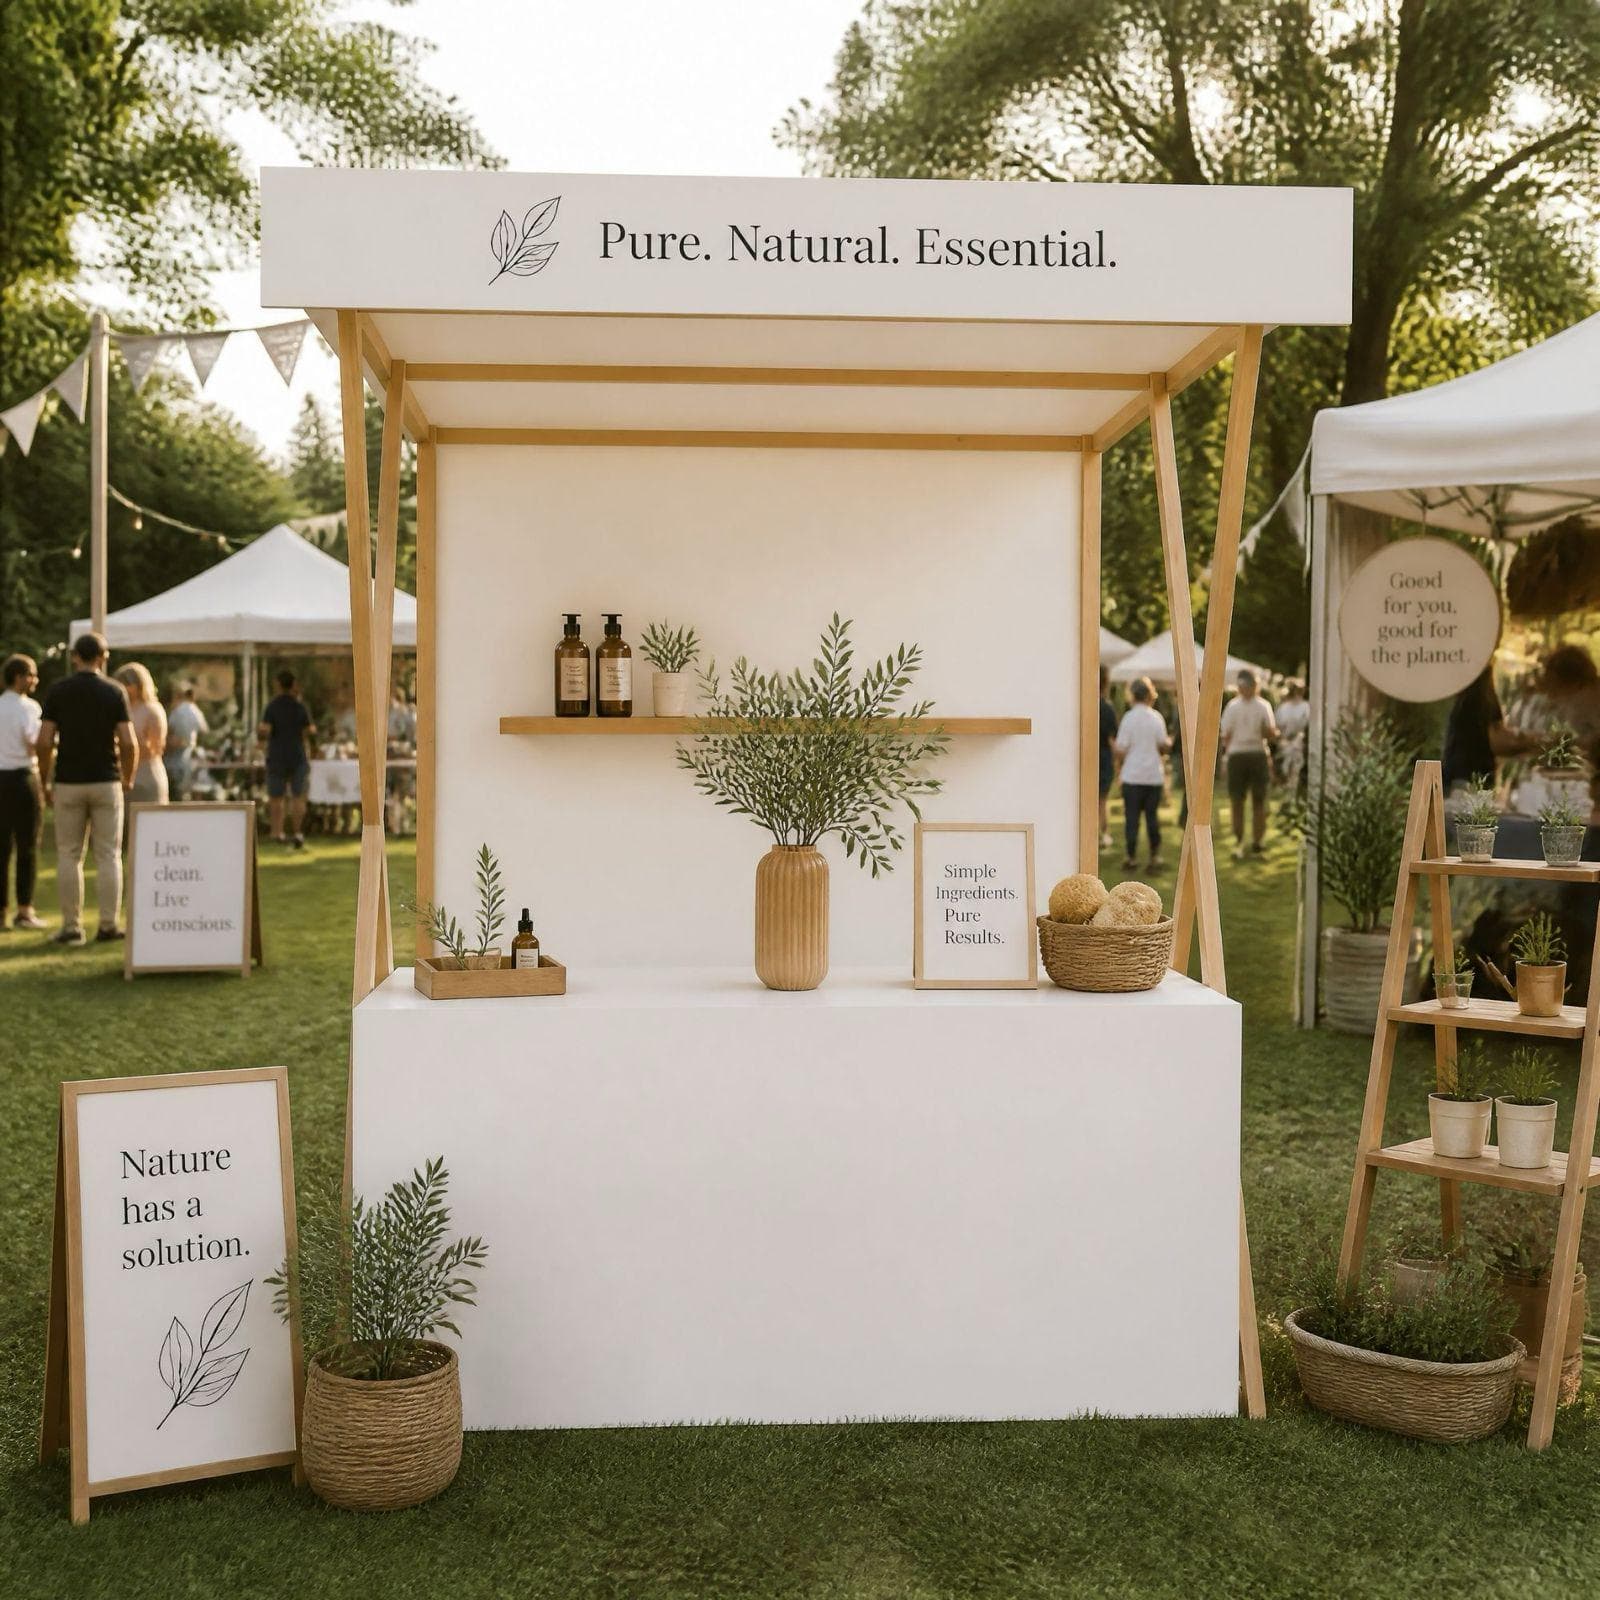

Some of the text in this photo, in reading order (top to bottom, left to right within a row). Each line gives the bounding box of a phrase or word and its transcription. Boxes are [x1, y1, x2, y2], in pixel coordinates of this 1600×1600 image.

[600, 221, 1118, 269] Pure. Natural. Essential.
[1389, 571, 1443, 590] Good
[1384, 596, 1412, 614] for
[1377, 620, 1458, 642] good for
[1371, 646, 1471, 668] the planet.
[154, 841, 190, 857] Live
[154, 865, 204, 882] clean.
[944, 863, 997, 883] Simple
[154, 891, 190, 907] Live
[936, 885, 1019, 904] Ingredients.
[152, 915, 236, 932] conscious.
[945, 908, 981, 923] Pure
[944, 929, 1005, 945] Results.
[120, 1147, 232, 1180] Nature
[121, 1196, 204, 1226] has a
[121, 1233, 251, 1271] solution.
